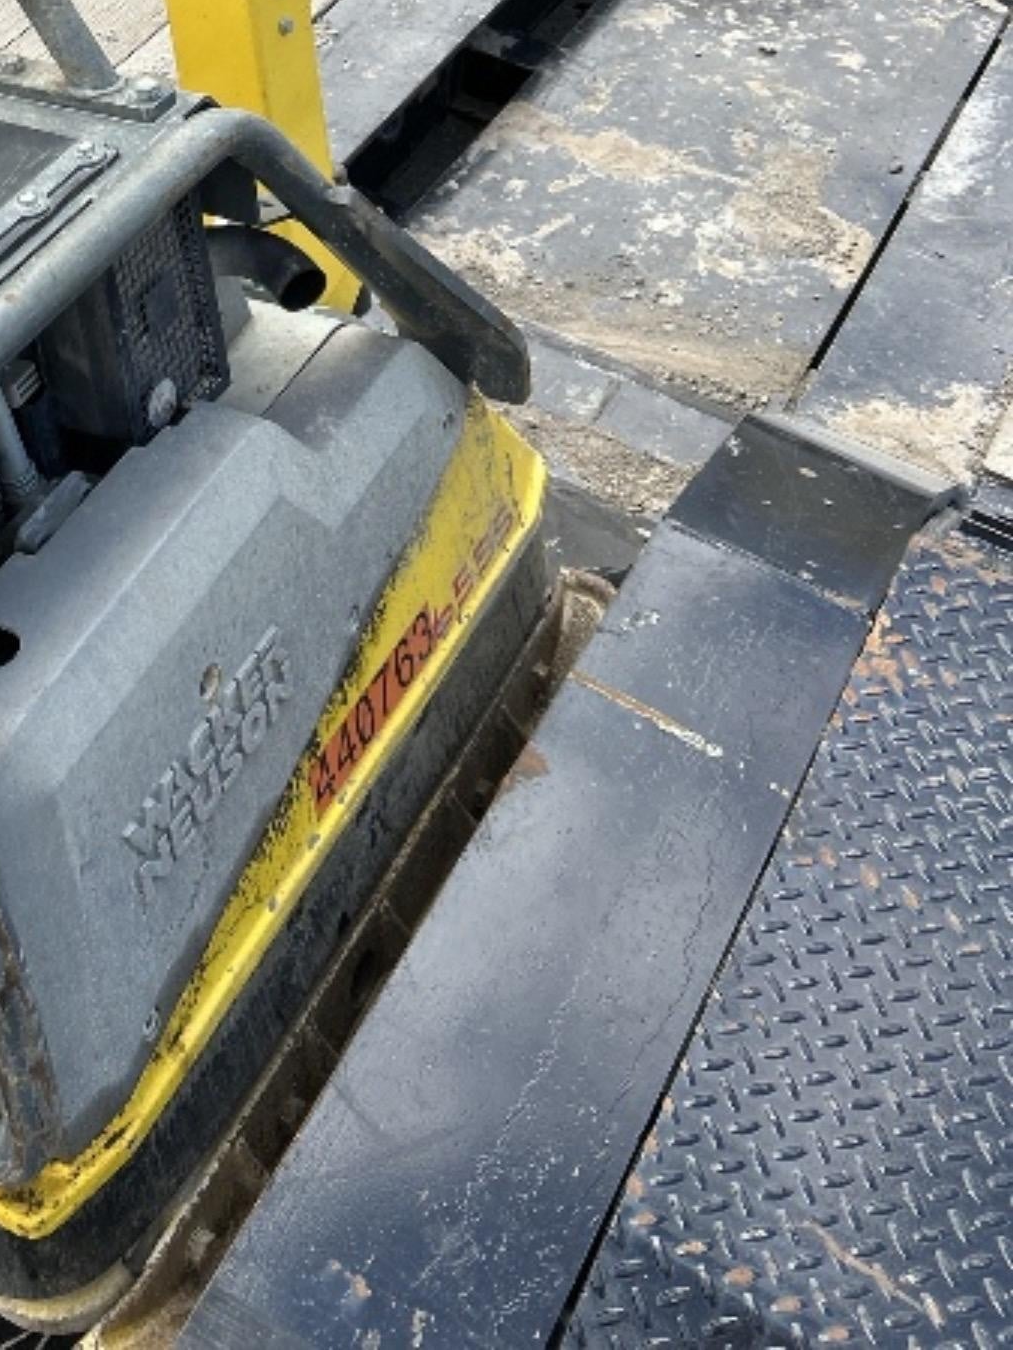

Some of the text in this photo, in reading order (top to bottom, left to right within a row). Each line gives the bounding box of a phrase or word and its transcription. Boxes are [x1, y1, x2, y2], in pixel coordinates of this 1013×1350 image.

[121, 624, 287, 856] WACKER
[134, 680, 290, 900] NEUSON
[316, 610, 432, 802] 440763
